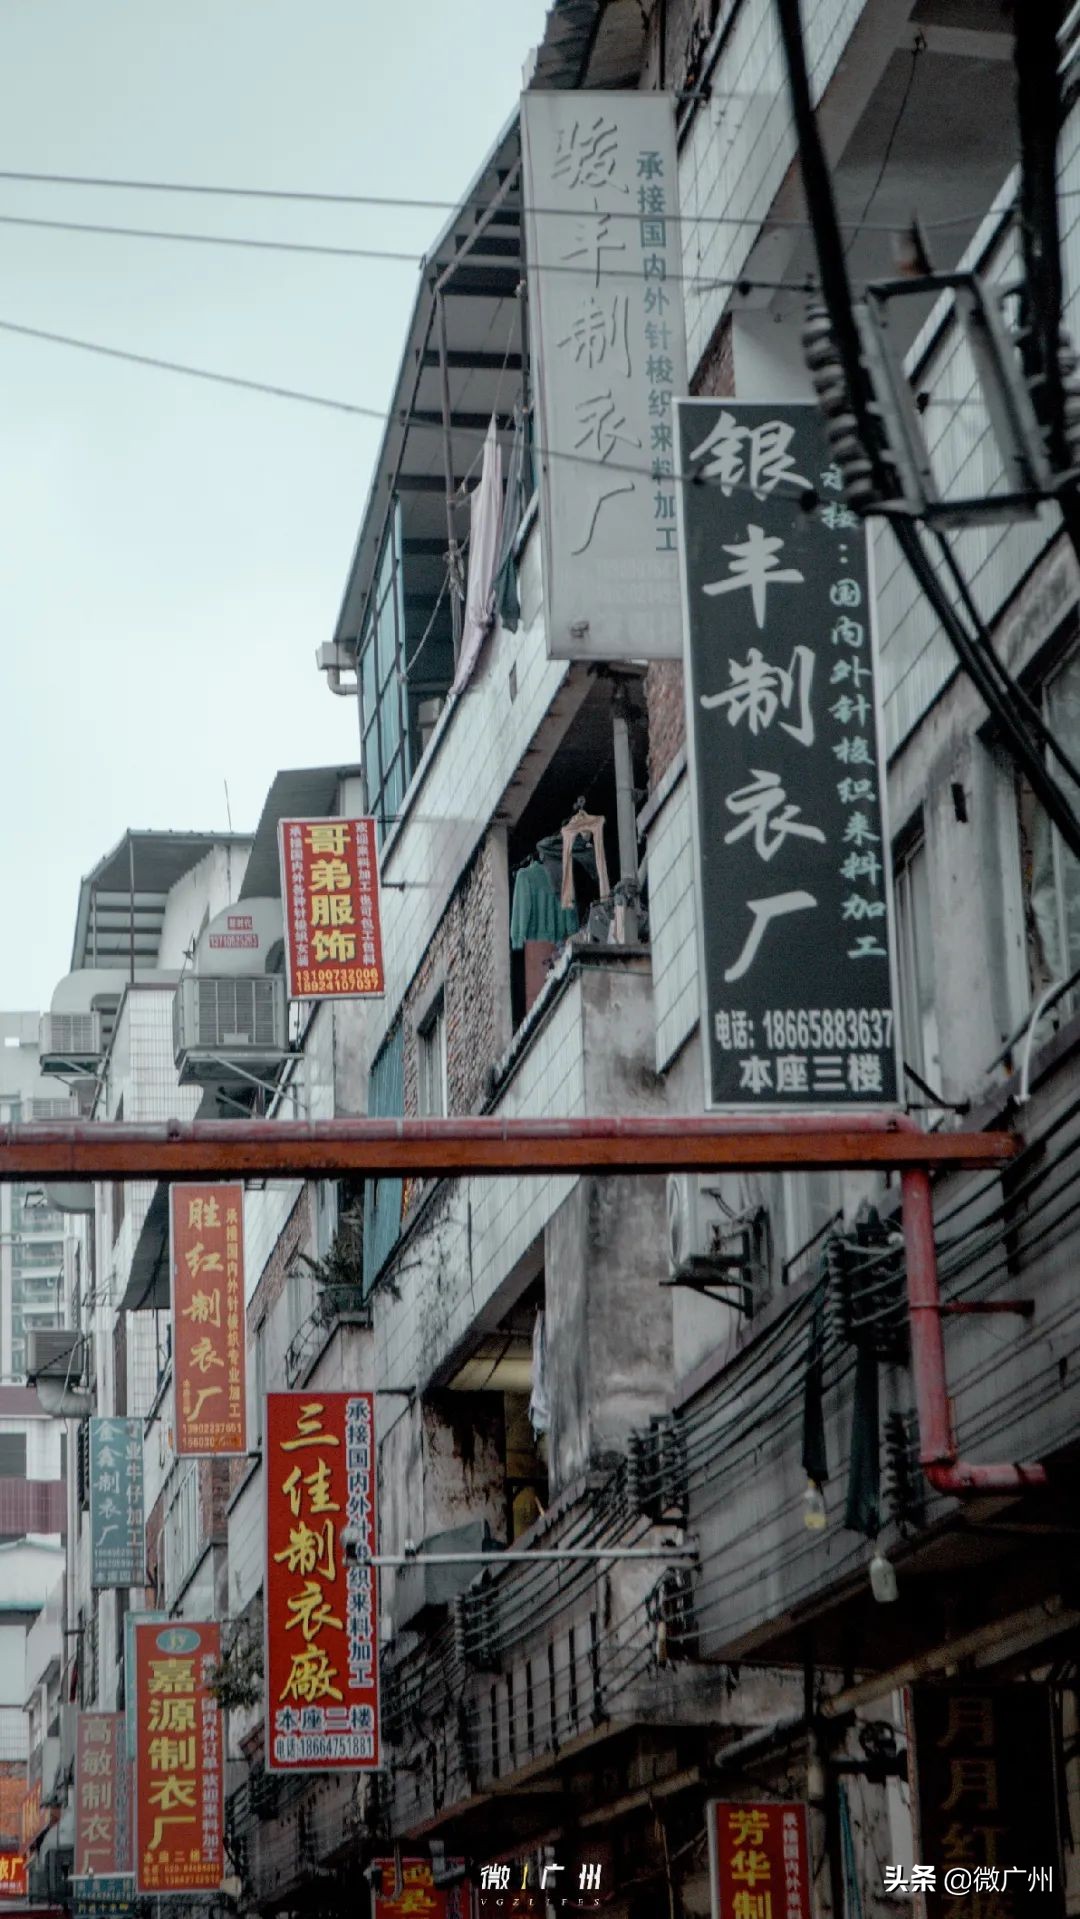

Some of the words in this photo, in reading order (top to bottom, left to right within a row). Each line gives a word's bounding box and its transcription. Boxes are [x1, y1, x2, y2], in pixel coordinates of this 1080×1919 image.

[689, 409, 828, 984] 银丰制衣厂
[304, 823, 357, 963] 哥弟服饰
[739, 1053, 883, 1094] 本座三楼
[762, 1008, 893, 1050] 18665883637
[181, 1195, 225, 1422] 胜红制衣厂
[273, 1402, 344, 1702] 三佳制衣廠
[80, 1716, 113, 1876] 高敏制衣厂
[147, 1657, 197, 1851] 嘉源制衣厂
[275, 1705, 374, 1733] 本座二楼
